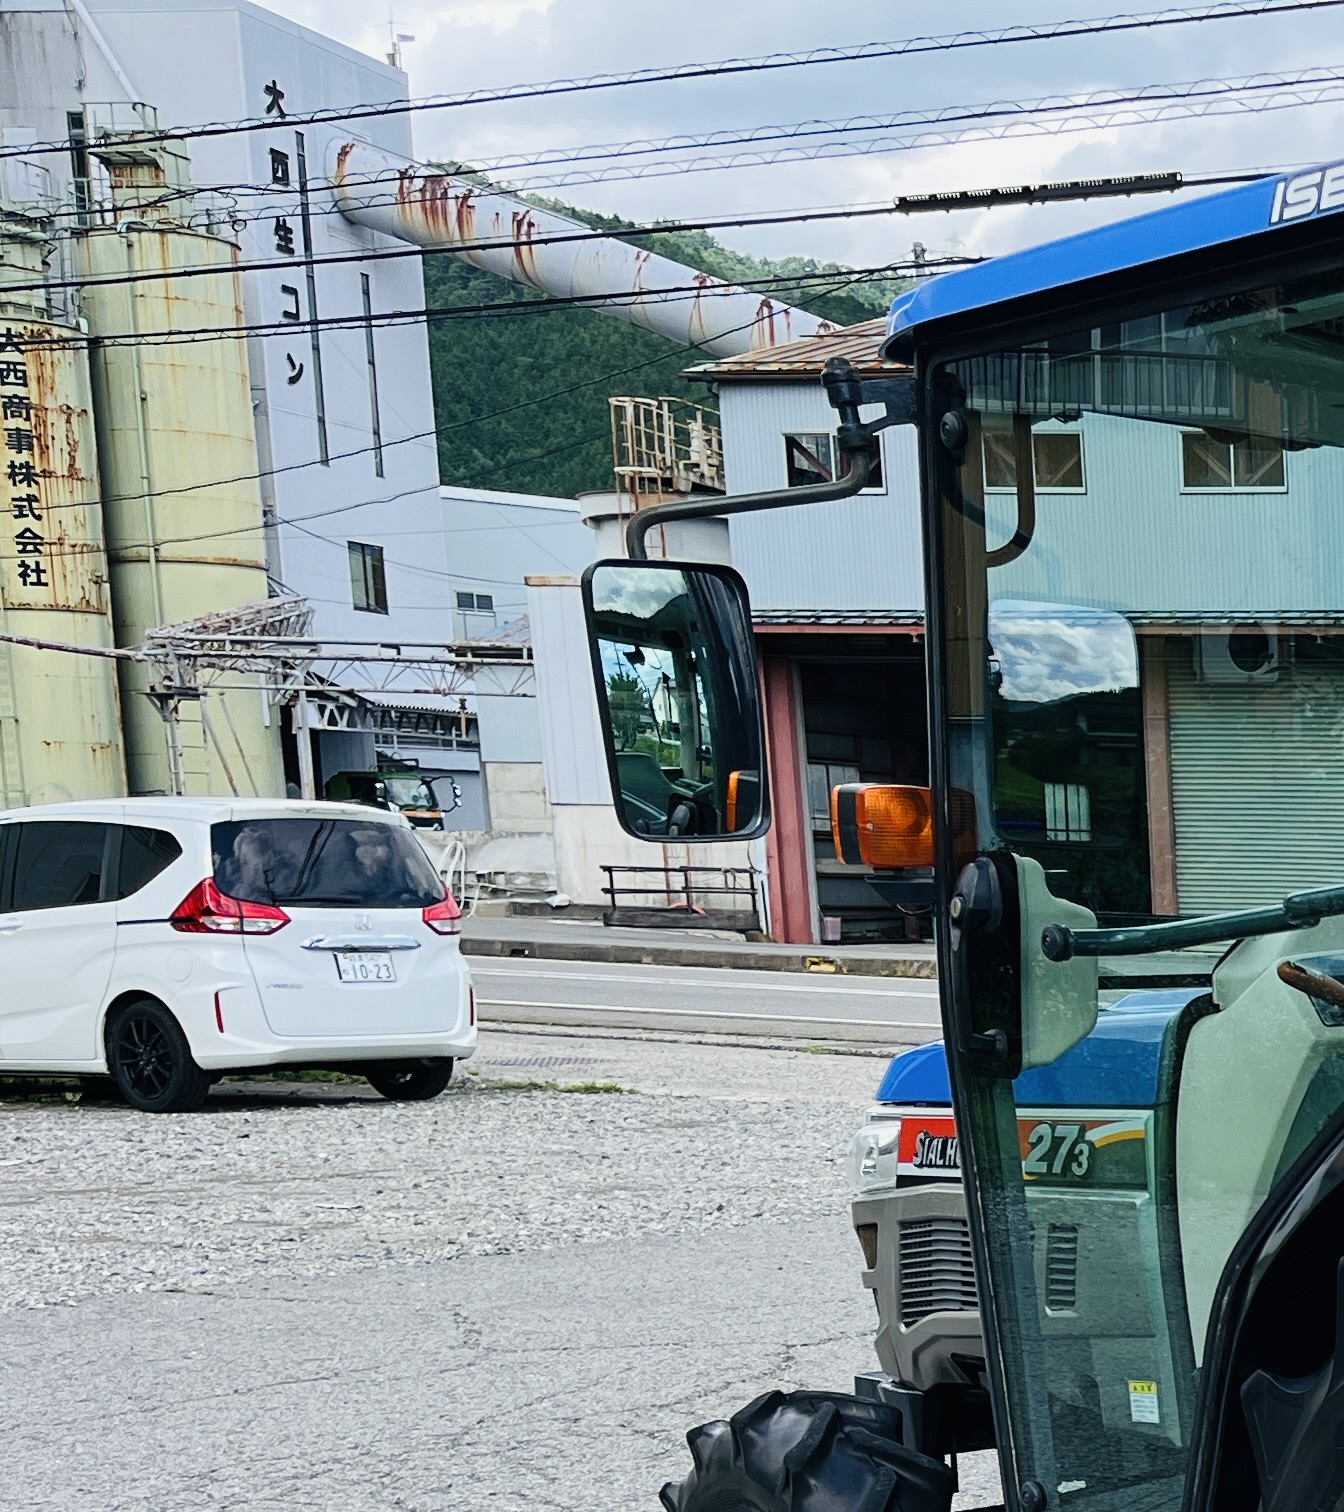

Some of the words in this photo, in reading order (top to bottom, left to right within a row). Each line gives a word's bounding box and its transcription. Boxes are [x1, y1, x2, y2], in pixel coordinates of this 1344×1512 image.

[263, 79, 304, 386] 大西生コン
[0, 327, 49, 588] 大西商事株式会社
[1023, 1121, 1091, 1178] 273
